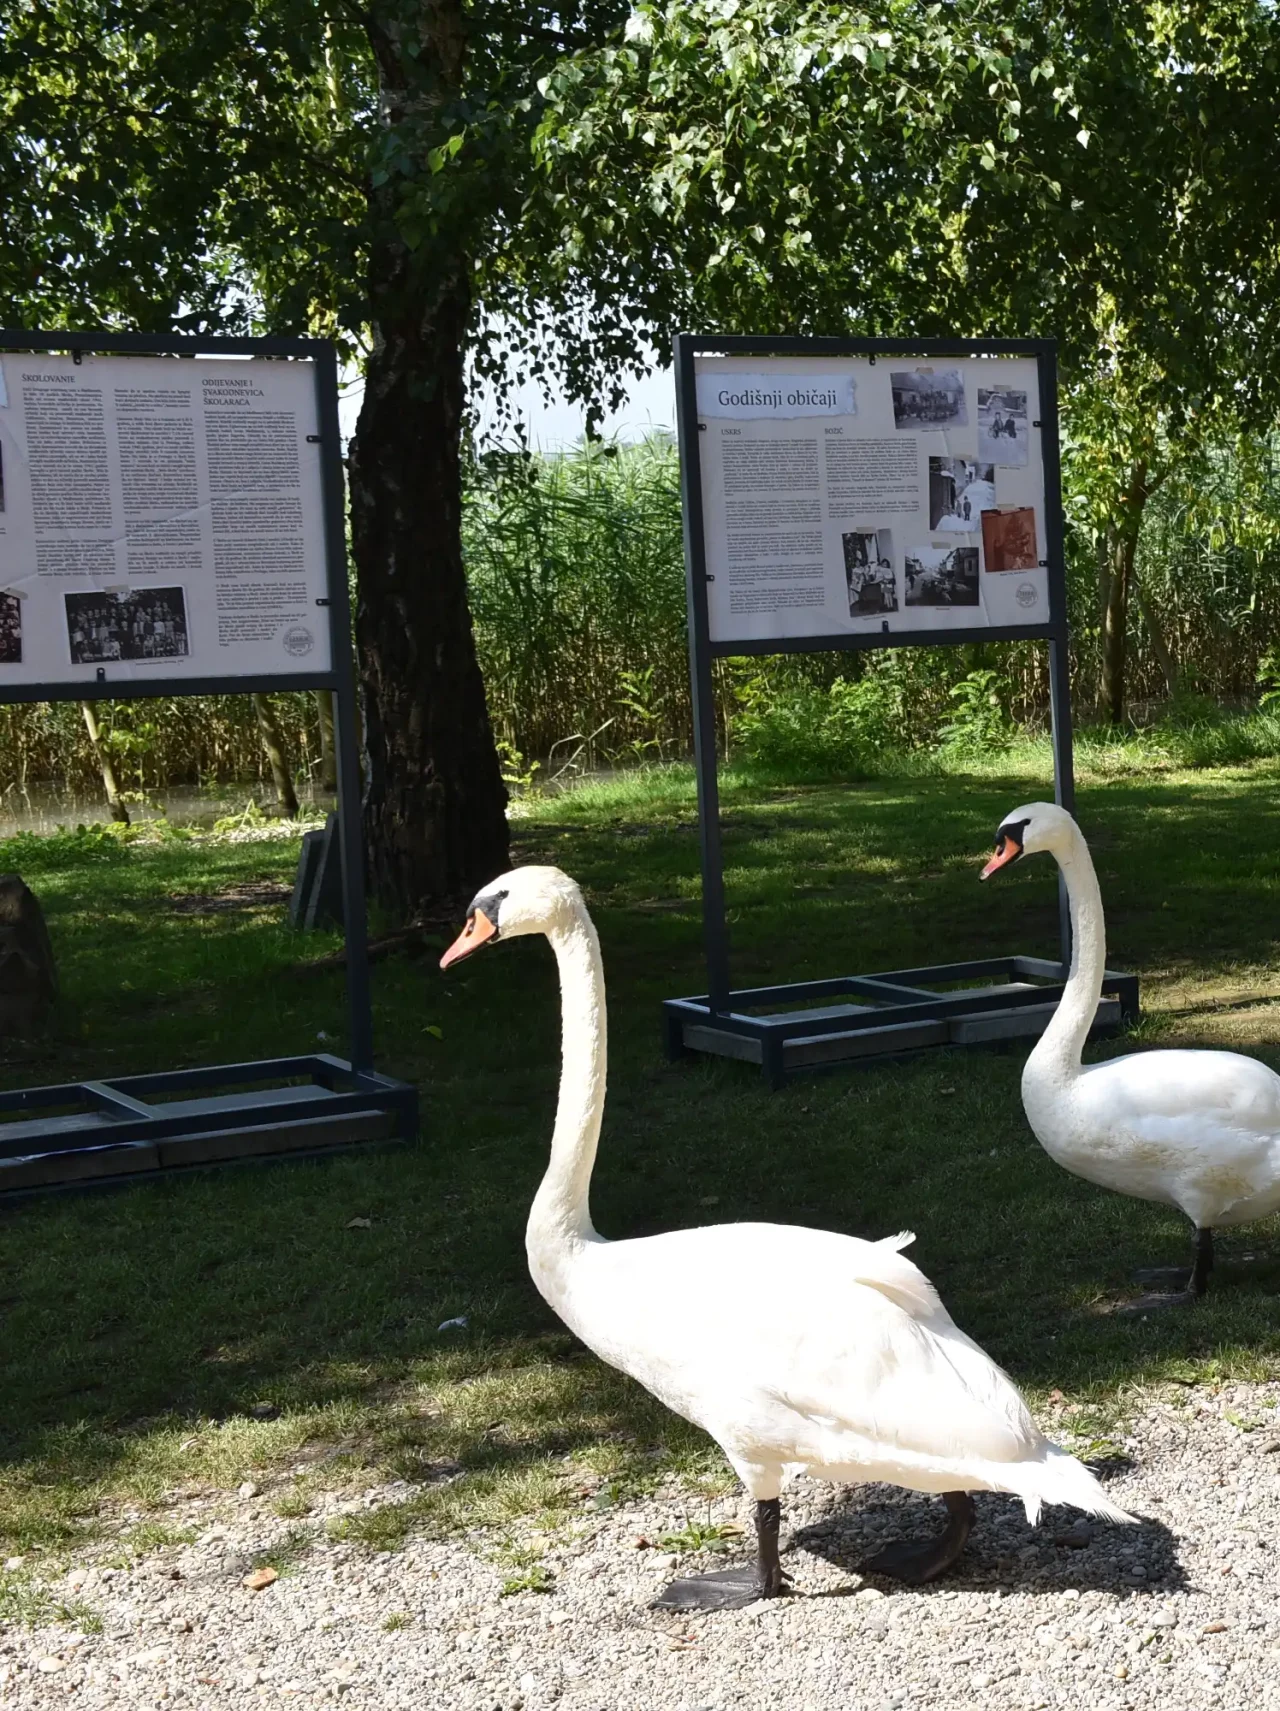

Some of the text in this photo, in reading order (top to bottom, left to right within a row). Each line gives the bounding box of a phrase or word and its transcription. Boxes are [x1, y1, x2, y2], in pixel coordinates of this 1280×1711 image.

[21, 373, 76, 384] ŠKOLOVANJE
[202, 379, 249, 387] ODIJEVANJE
[202, 388, 265, 397] SVAKODNEVICA
[203, 397, 250, 406] ŠKOLARACA
[718, 389, 838, 409] Godišnji običaji
[721, 428, 742, 436] USKRS
